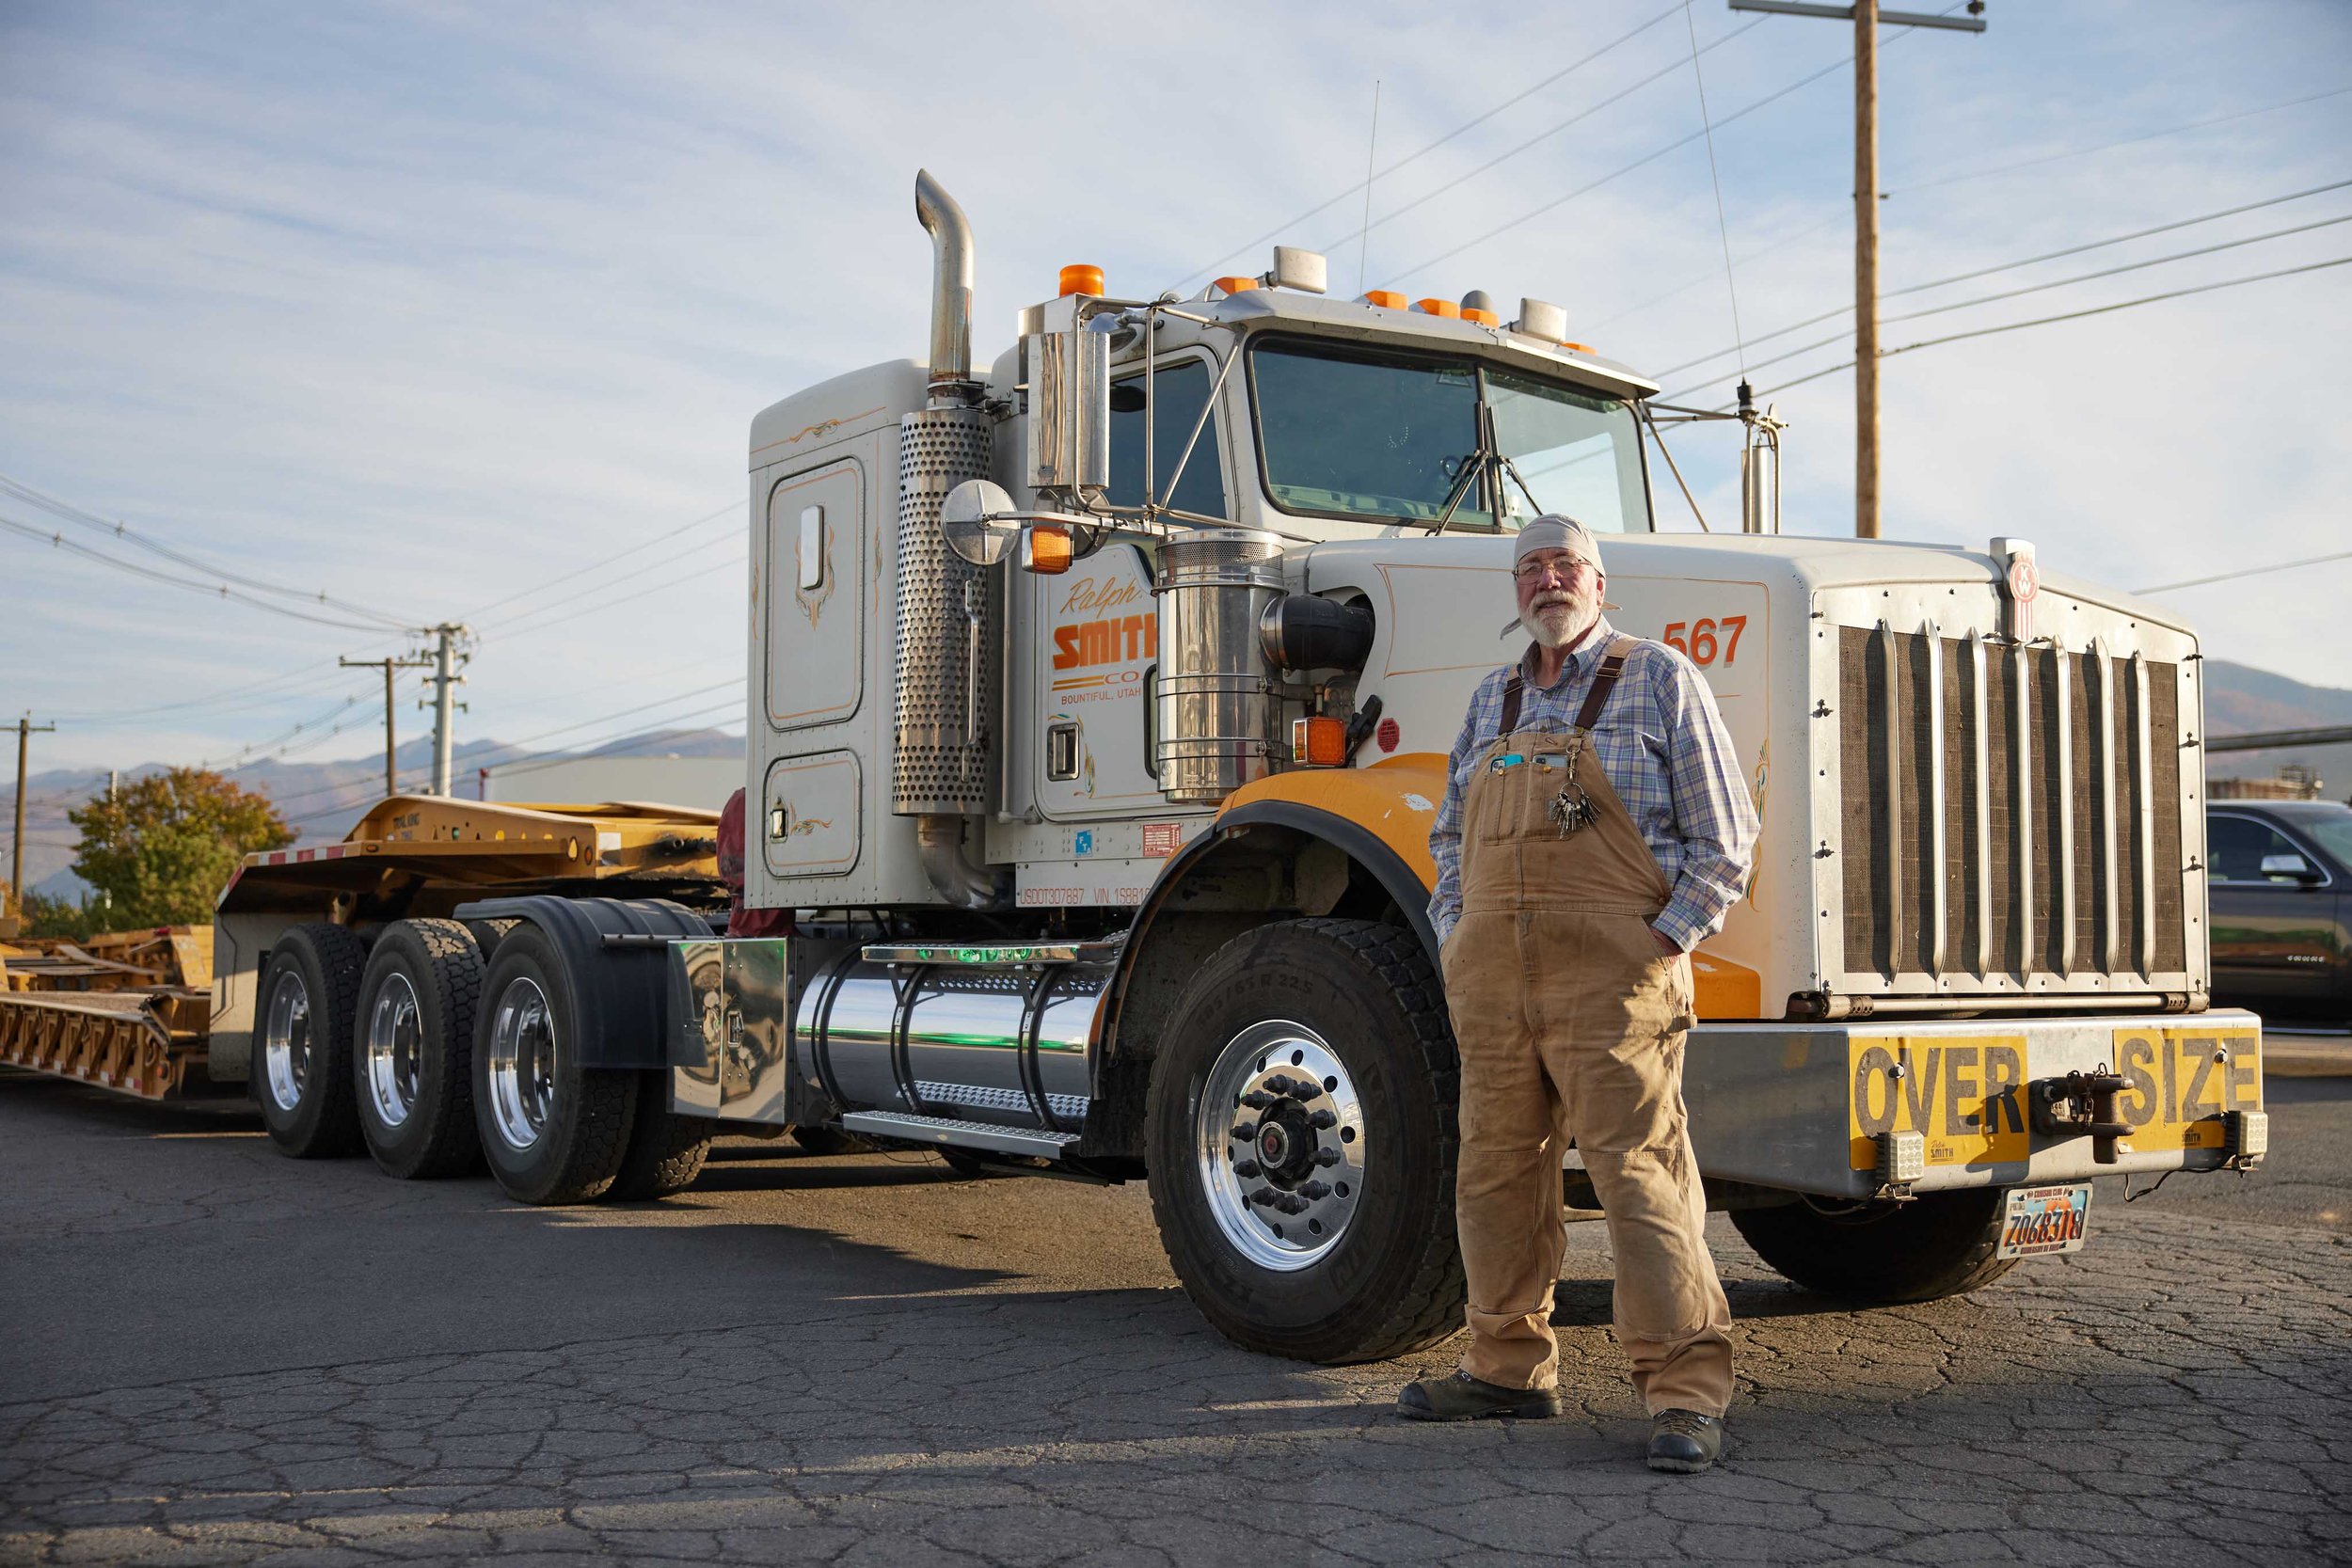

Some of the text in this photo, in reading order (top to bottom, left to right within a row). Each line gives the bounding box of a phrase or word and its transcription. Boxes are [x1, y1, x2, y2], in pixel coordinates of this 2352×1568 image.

[1059, 577, 1141, 619] Ralph
[1053, 612, 1157, 671] SMITH
[1664, 615, 1746, 668] 567
[1061, 687, 1141, 705] BOUNTIFUL, UTAH
[1020, 887, 1085, 905] USDOT307887
[1855, 1037, 2257, 1137] OVER SIZE
[1931, 1148, 1953, 1158] SMITH
